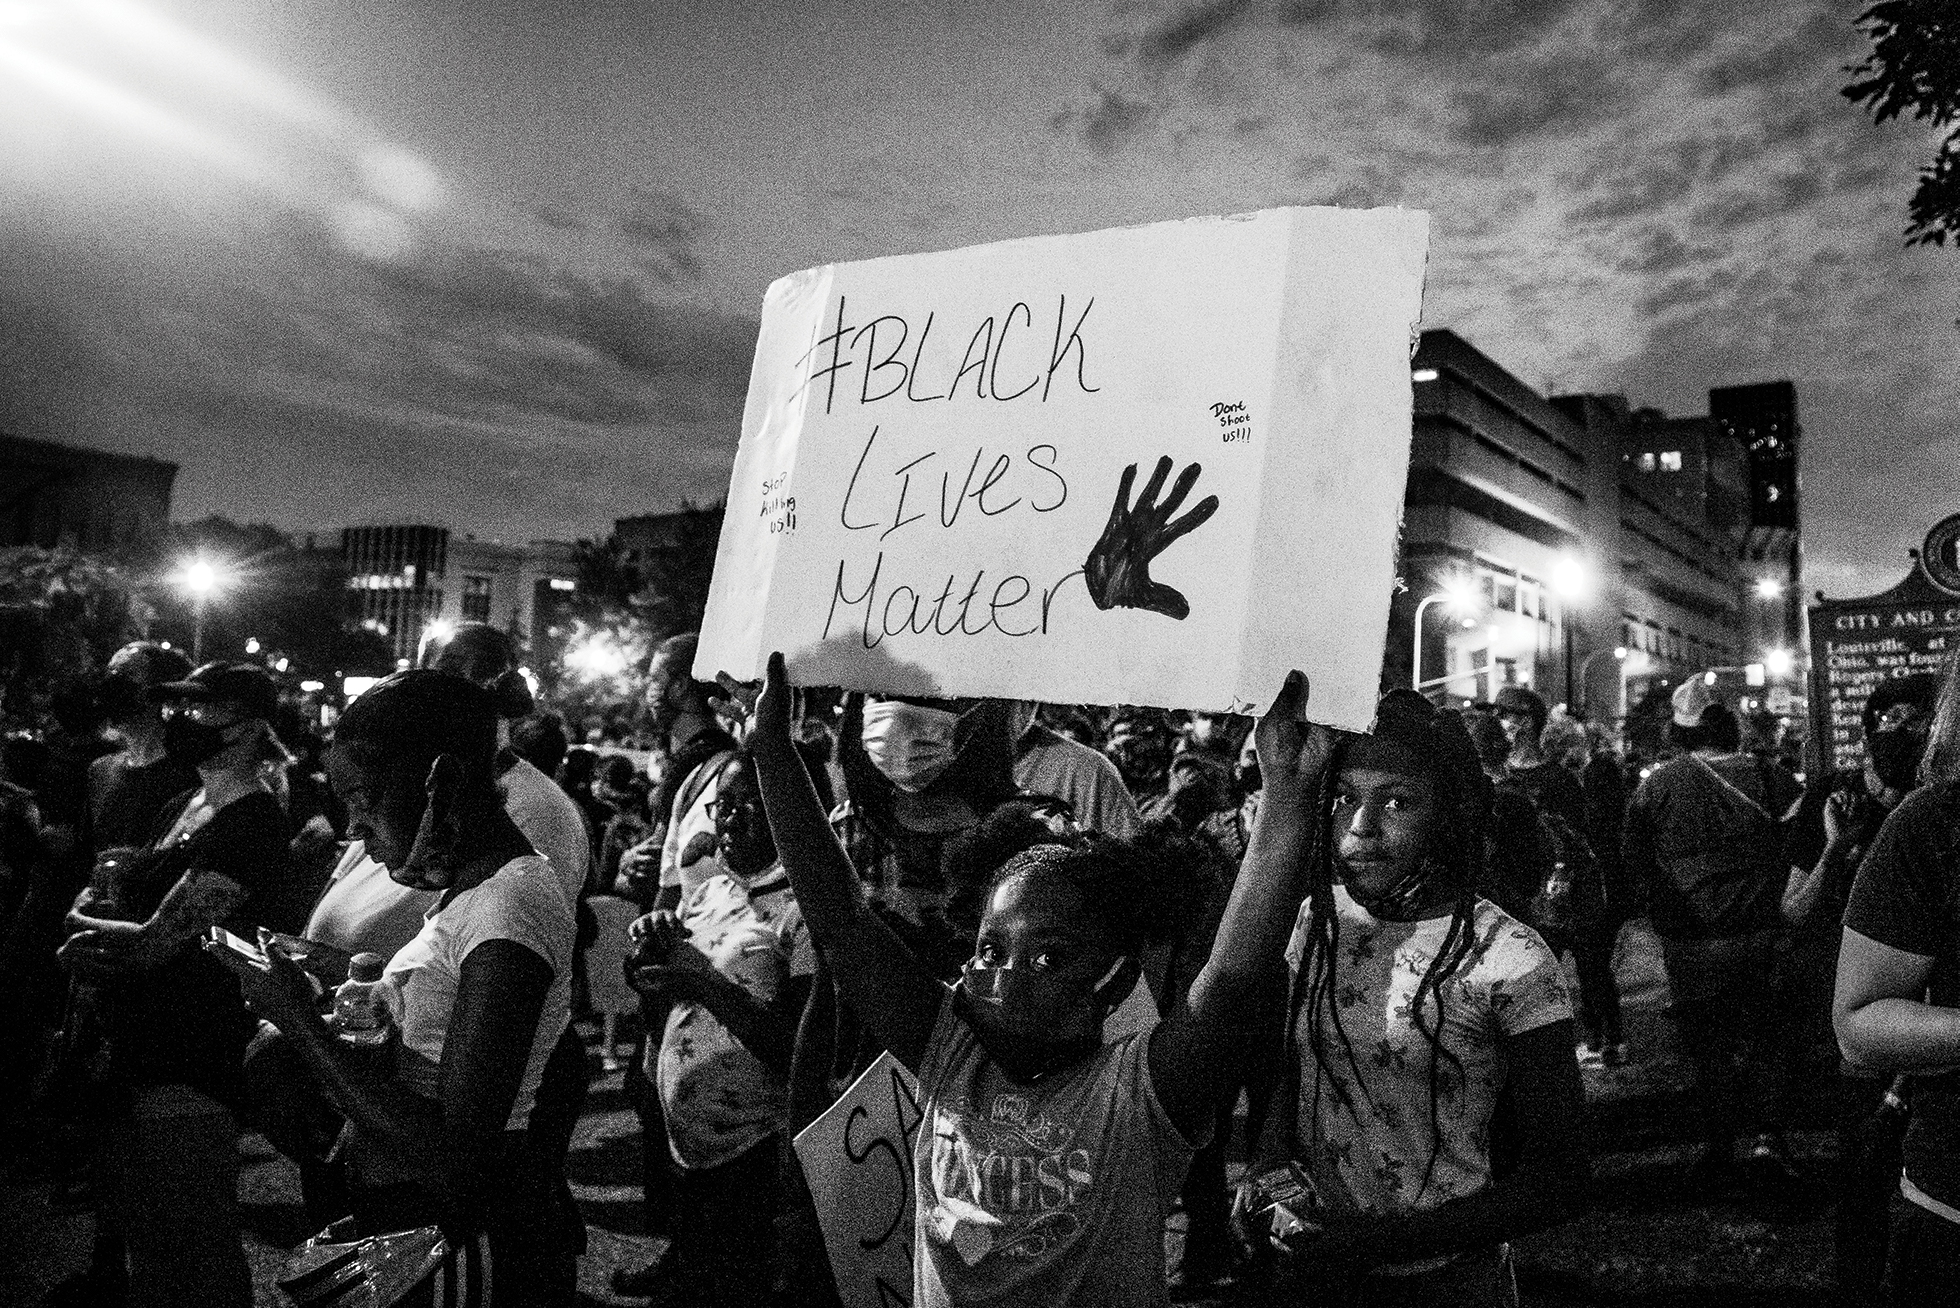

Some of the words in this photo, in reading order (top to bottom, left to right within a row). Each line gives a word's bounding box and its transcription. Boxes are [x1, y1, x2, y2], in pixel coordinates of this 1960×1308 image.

[789, 294, 1101, 414] #BLACK
[1209, 400, 1247, 418] Dont
[823, 552, 1085, 649] Matter
[1835, 614, 1880, 629] CITY
[1891, 610, 1934, 626] AND
[1944, 609, 1960, 622] C
